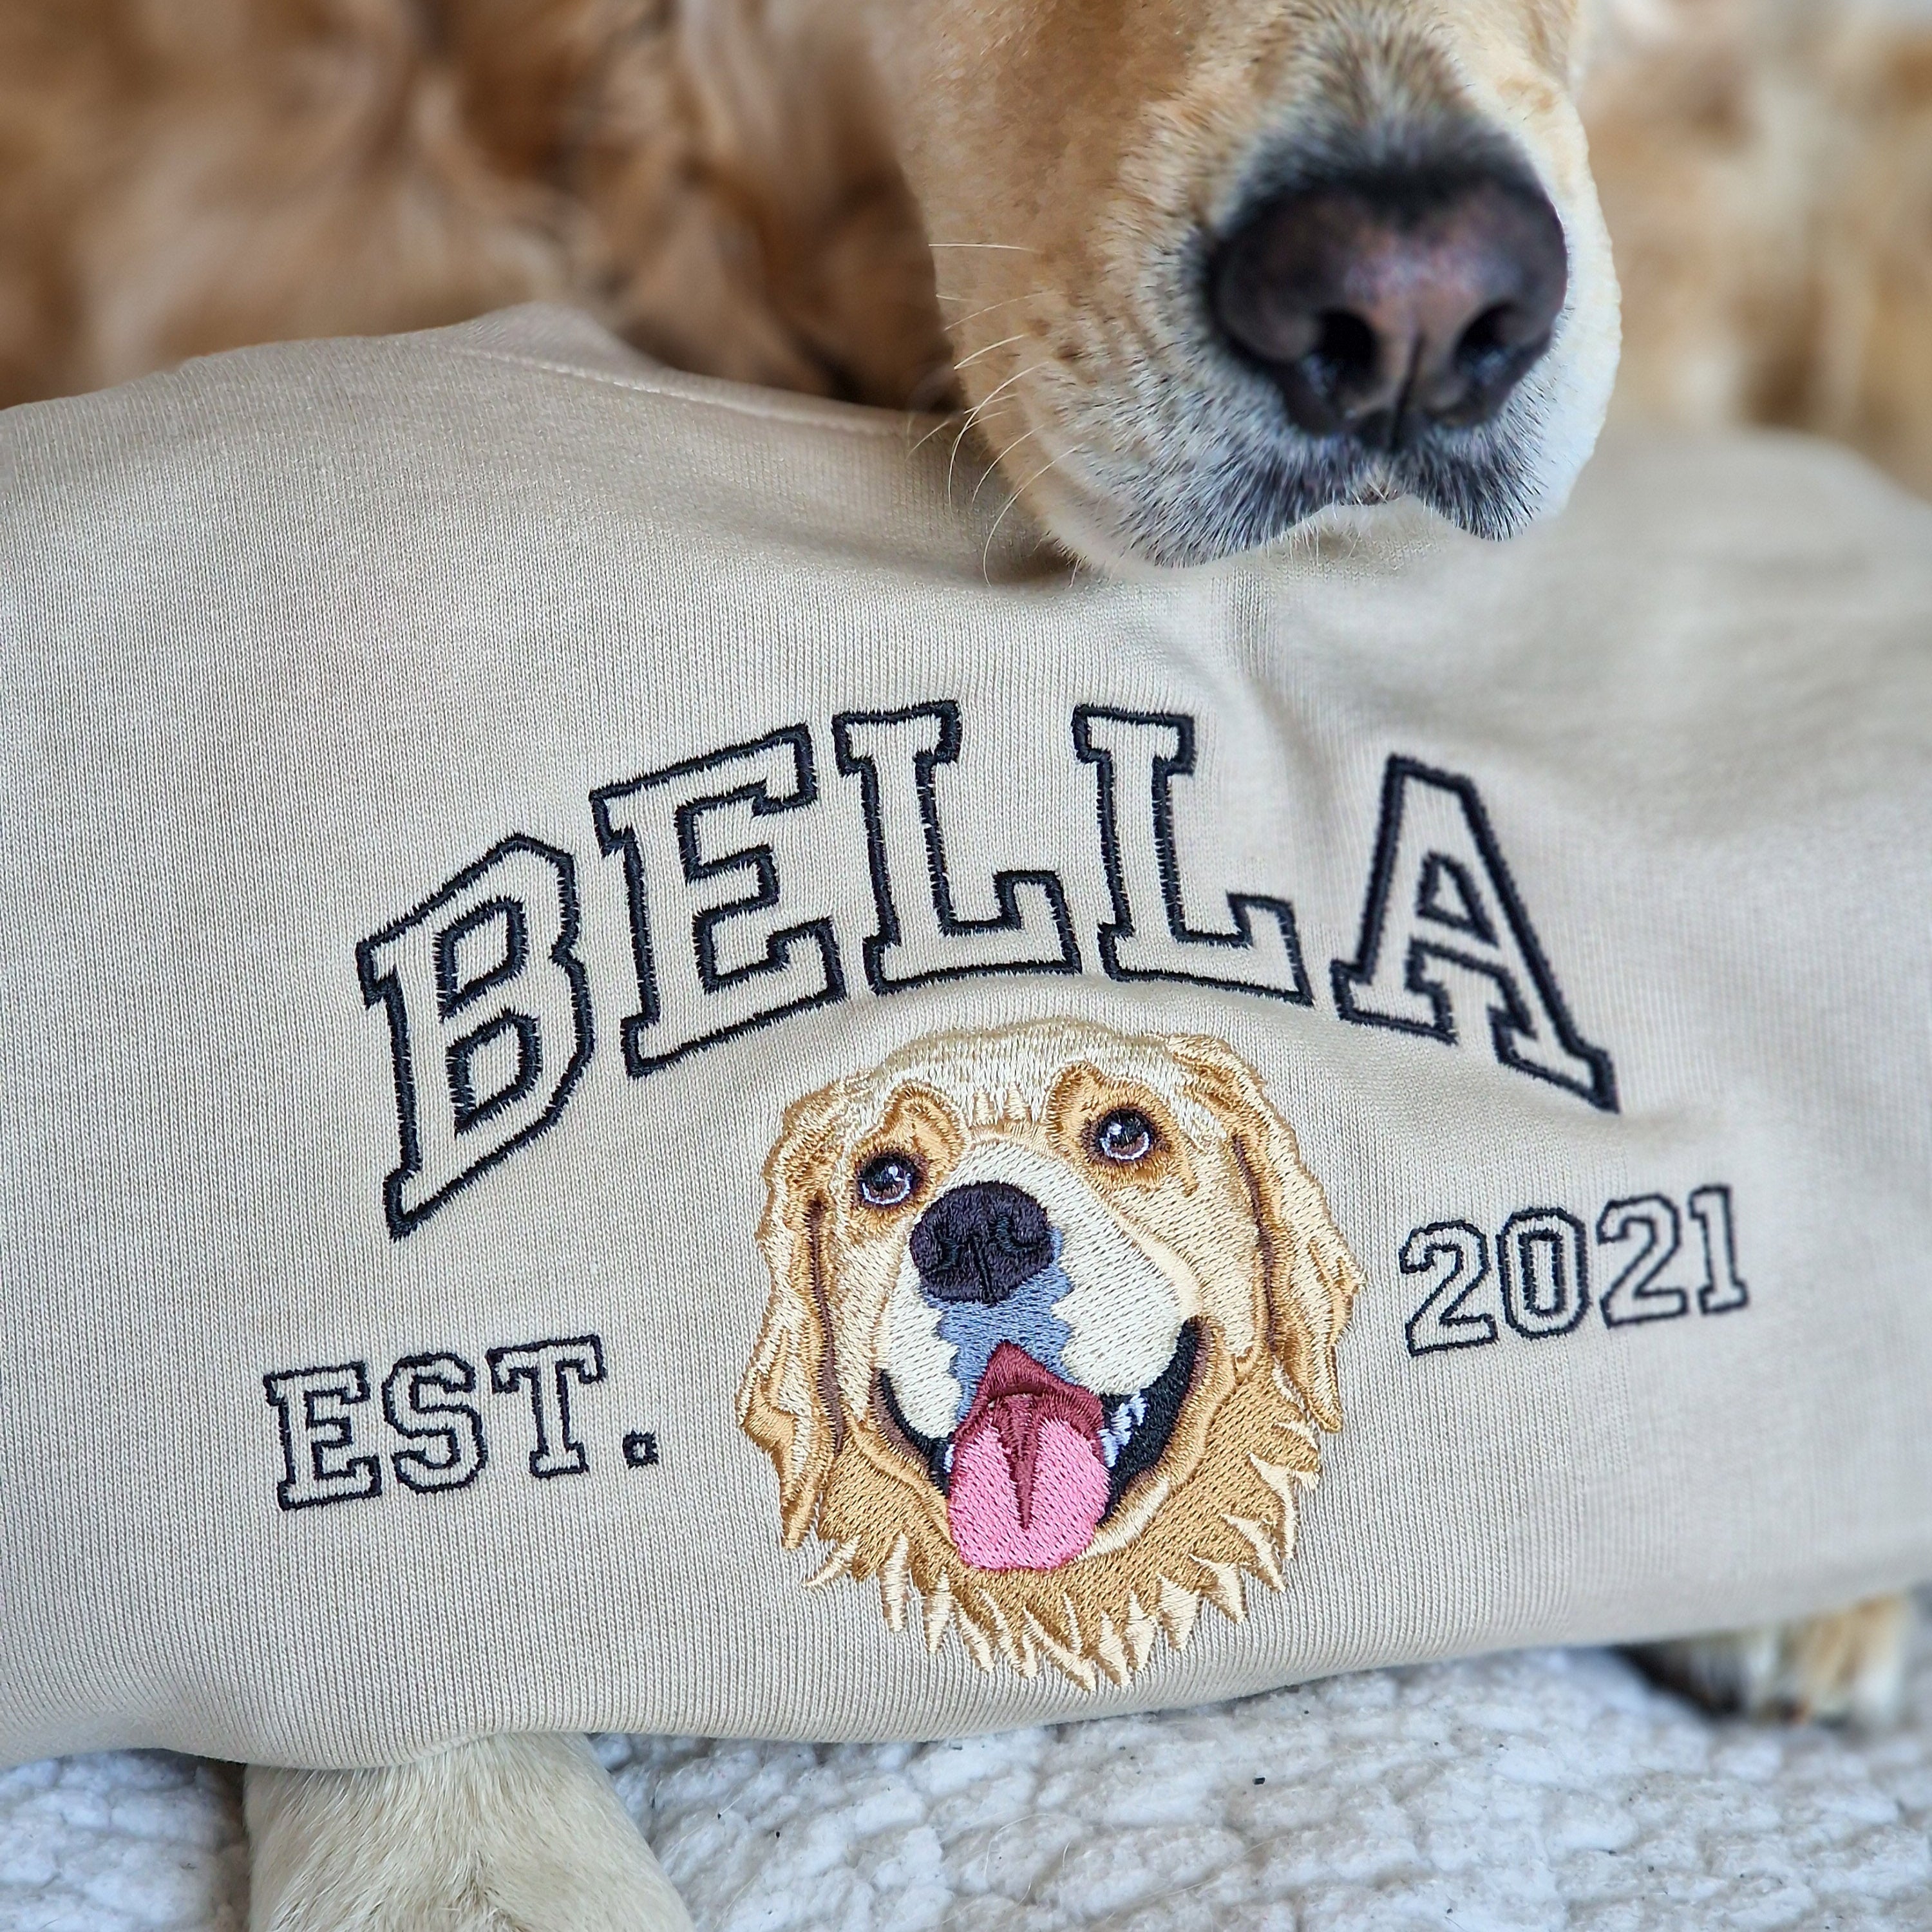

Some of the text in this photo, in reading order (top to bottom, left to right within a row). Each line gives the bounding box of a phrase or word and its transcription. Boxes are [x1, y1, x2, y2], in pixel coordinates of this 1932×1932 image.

[355, 698, 1618, 1238] BELLA
[1397, 1183, 1750, 1358] 2021
[262, 1333, 659, 1513] EST.
